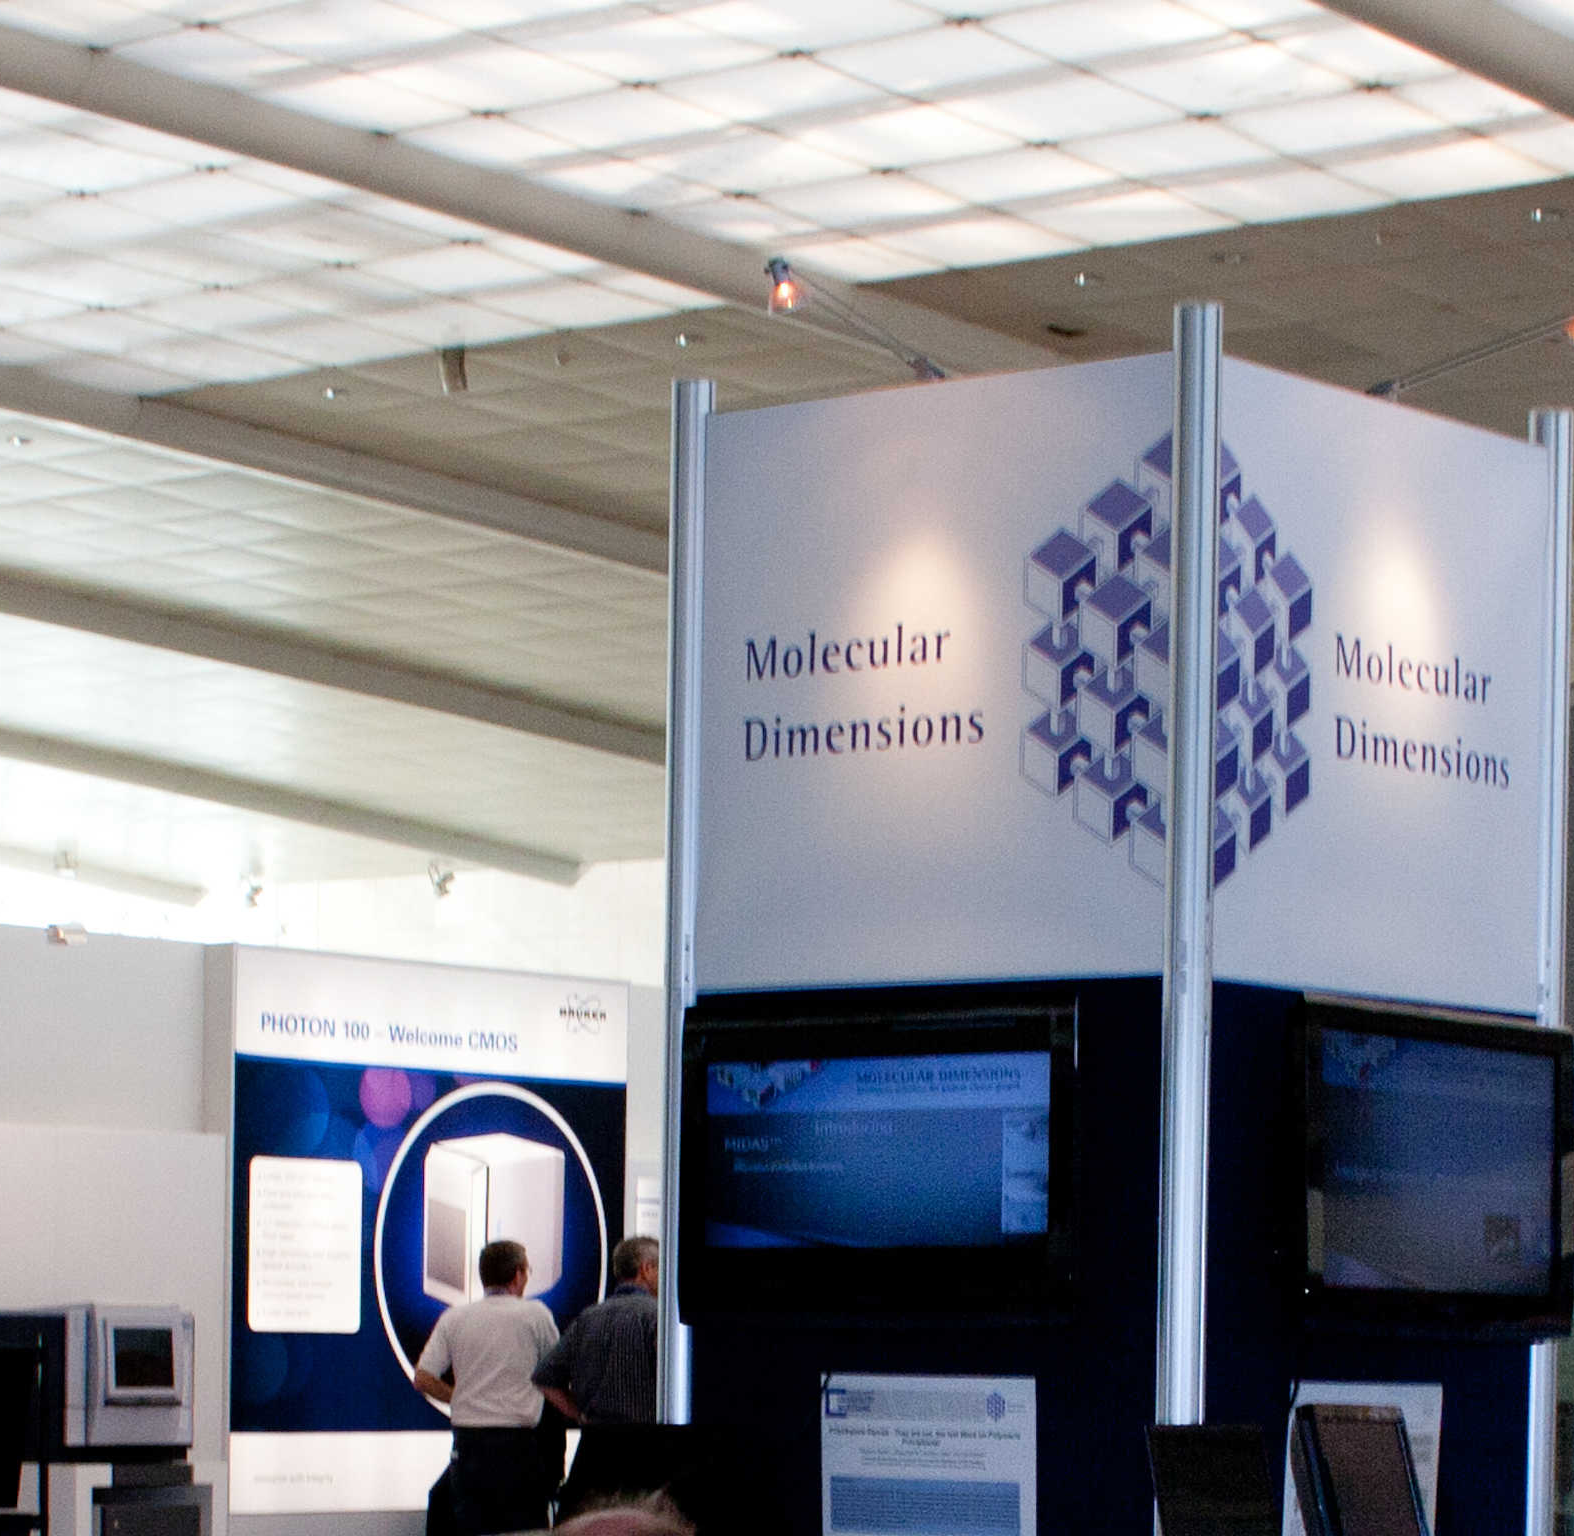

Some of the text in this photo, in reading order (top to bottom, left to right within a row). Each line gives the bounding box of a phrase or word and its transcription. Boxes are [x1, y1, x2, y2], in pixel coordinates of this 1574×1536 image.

[745, 621, 950, 682] Molecular
[1335, 632, 1492, 704] Molecular
[744, 704, 984, 762] Dimensions
[1335, 713, 1510, 789] Dimensions
[260, 1011, 336, 1037] PHOTON
[344, 1020, 370, 1041] 100
[388, 1025, 463, 1048] Welcome
[468, 1032, 519, 1053] CMOS
